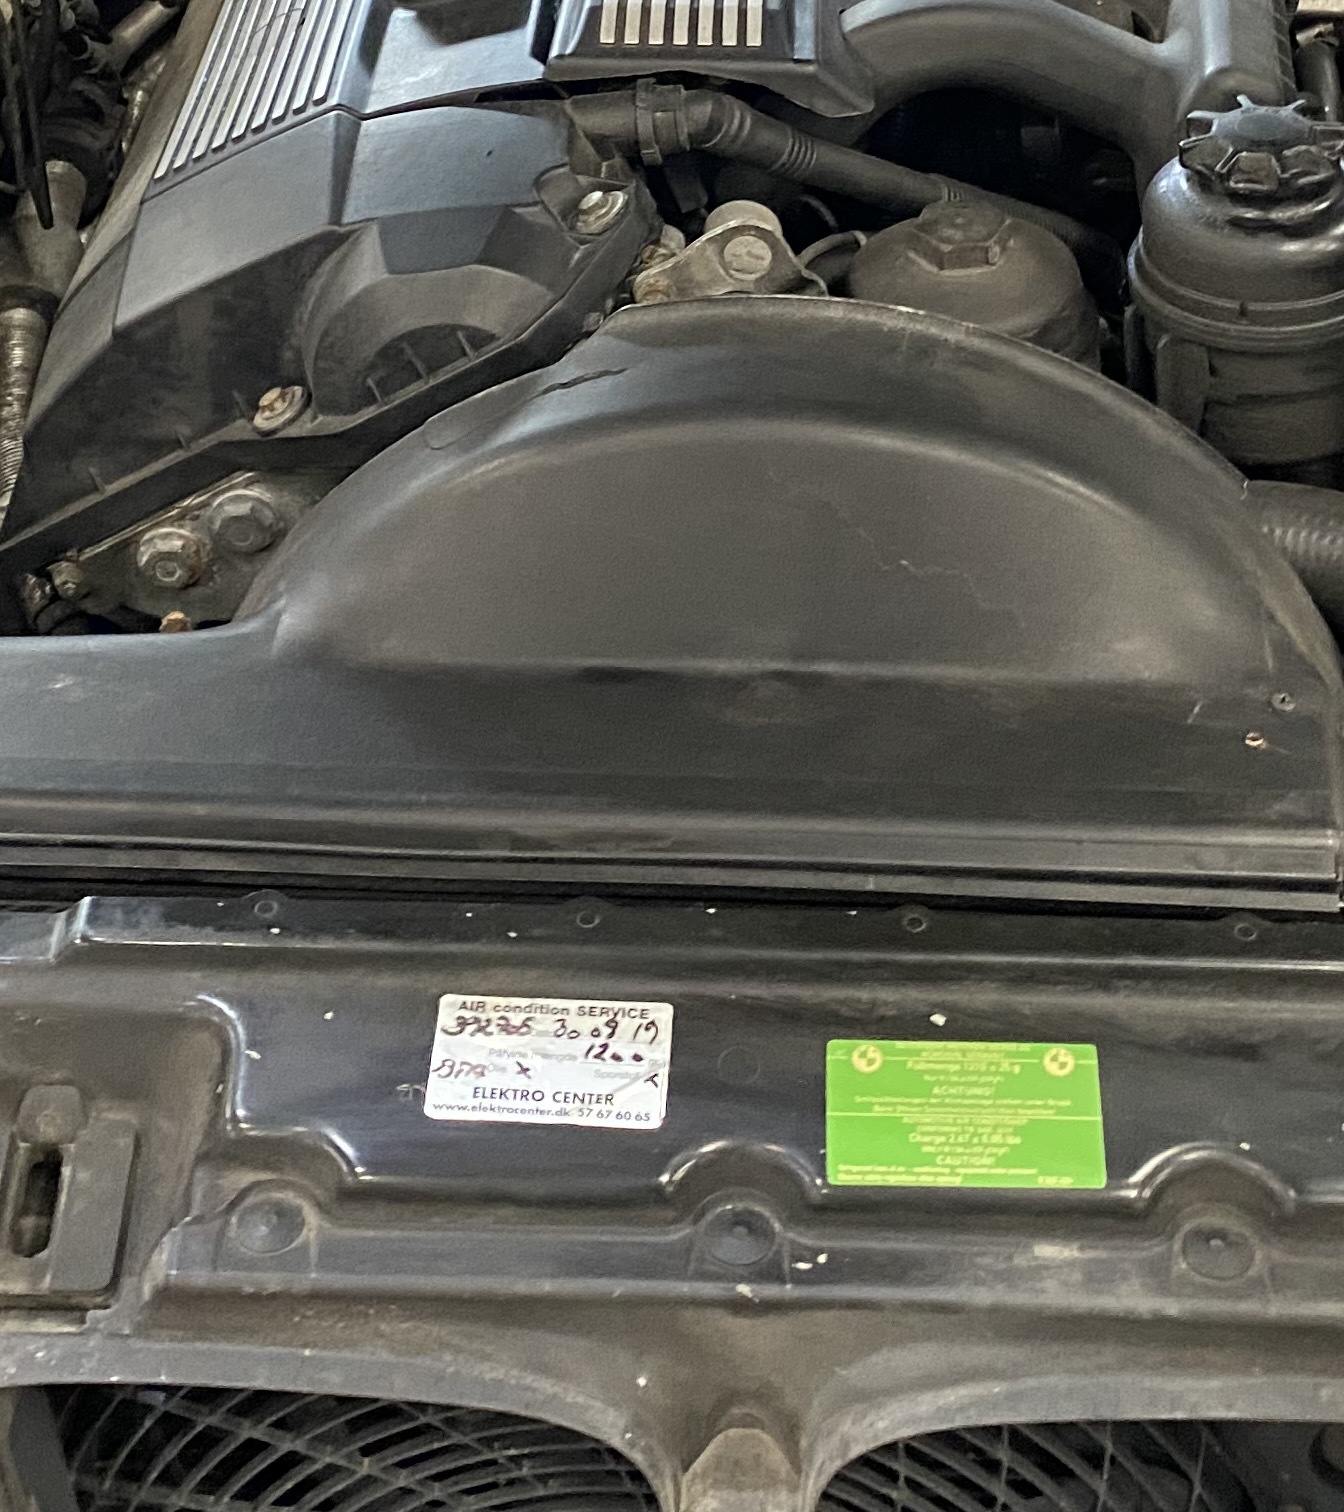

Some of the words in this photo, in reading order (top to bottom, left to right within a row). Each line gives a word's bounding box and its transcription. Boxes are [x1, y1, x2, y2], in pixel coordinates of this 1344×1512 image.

[458, 1000, 486, 1012] AIR
[492, 1003, 570, 1017] condition
[576, 1005, 652, 1020] SERVICE
[472, 1086, 545, 1102] ELEKTRO
[552, 1090, 615, 1106] CENTER
[432, 1101, 571, 1118] www.elektrocenter.dk
[577, 1107, 595, 1118] 57
[596, 1108, 614, 1120] 67
[615, 1110, 632, 1122] 60
[634, 1111, 651, 1122] 65
